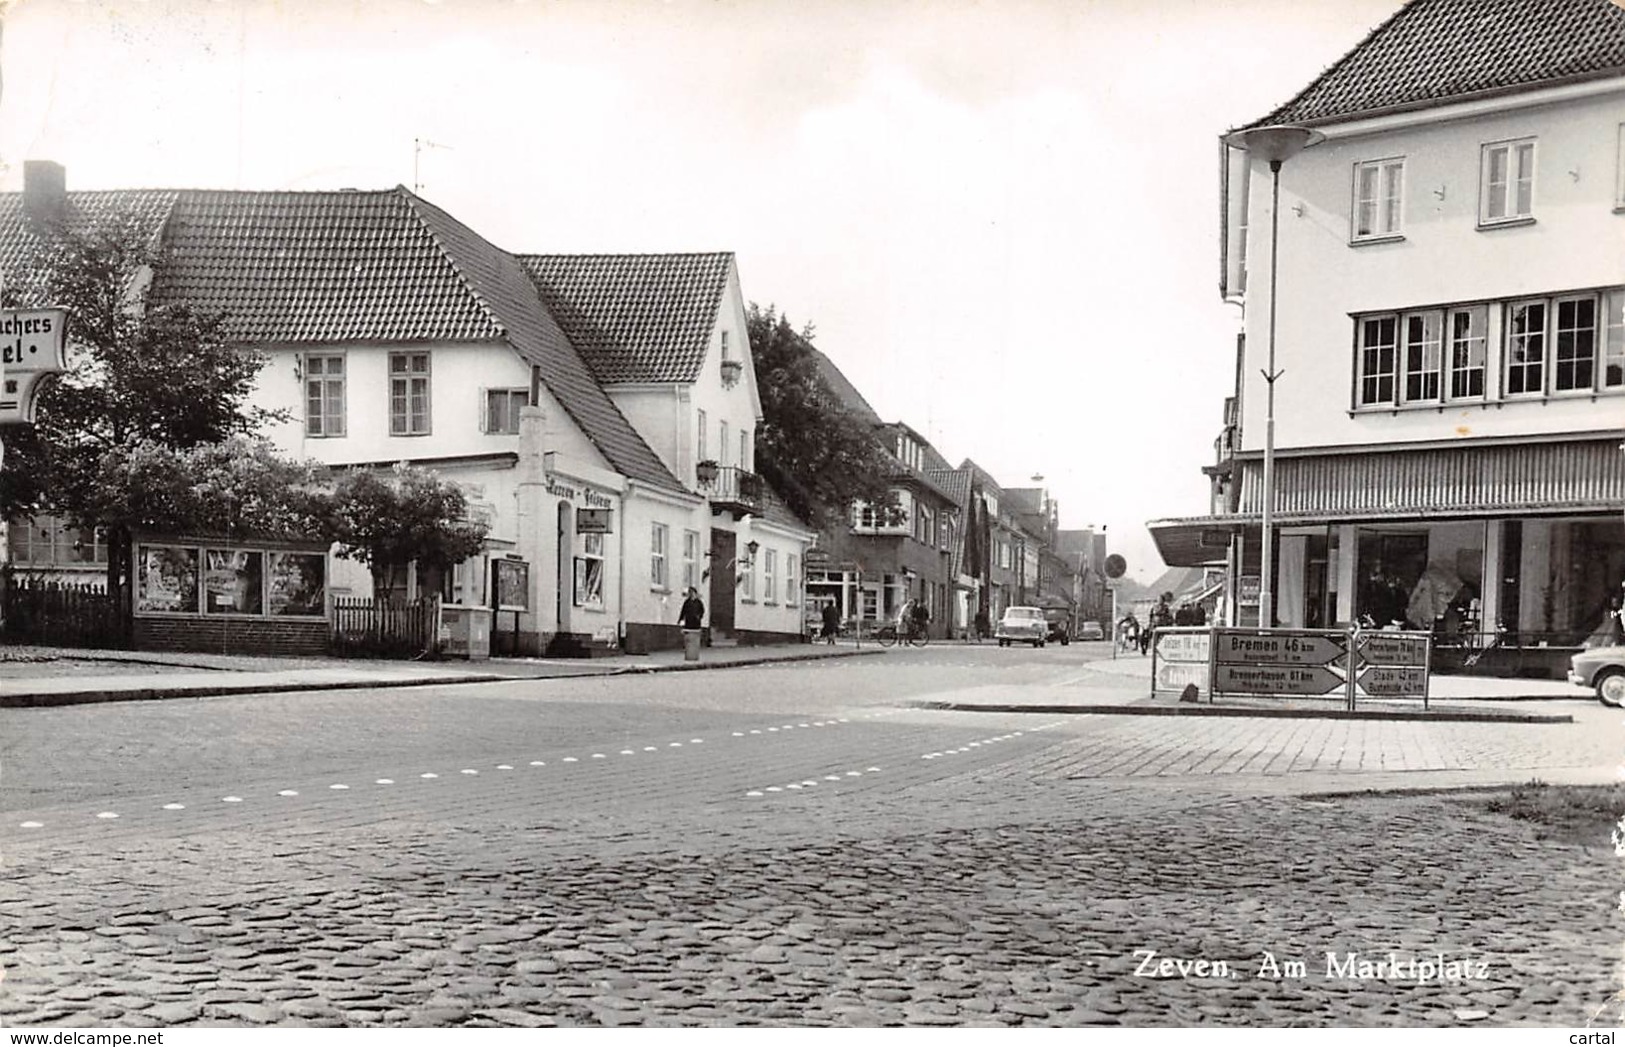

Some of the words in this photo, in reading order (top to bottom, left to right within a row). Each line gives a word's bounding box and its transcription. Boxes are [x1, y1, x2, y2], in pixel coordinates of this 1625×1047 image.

[1231, 636, 1278, 652] Bremen
[1285, 638, 1299, 652] 46
[1302, 640, 1315, 652] km
